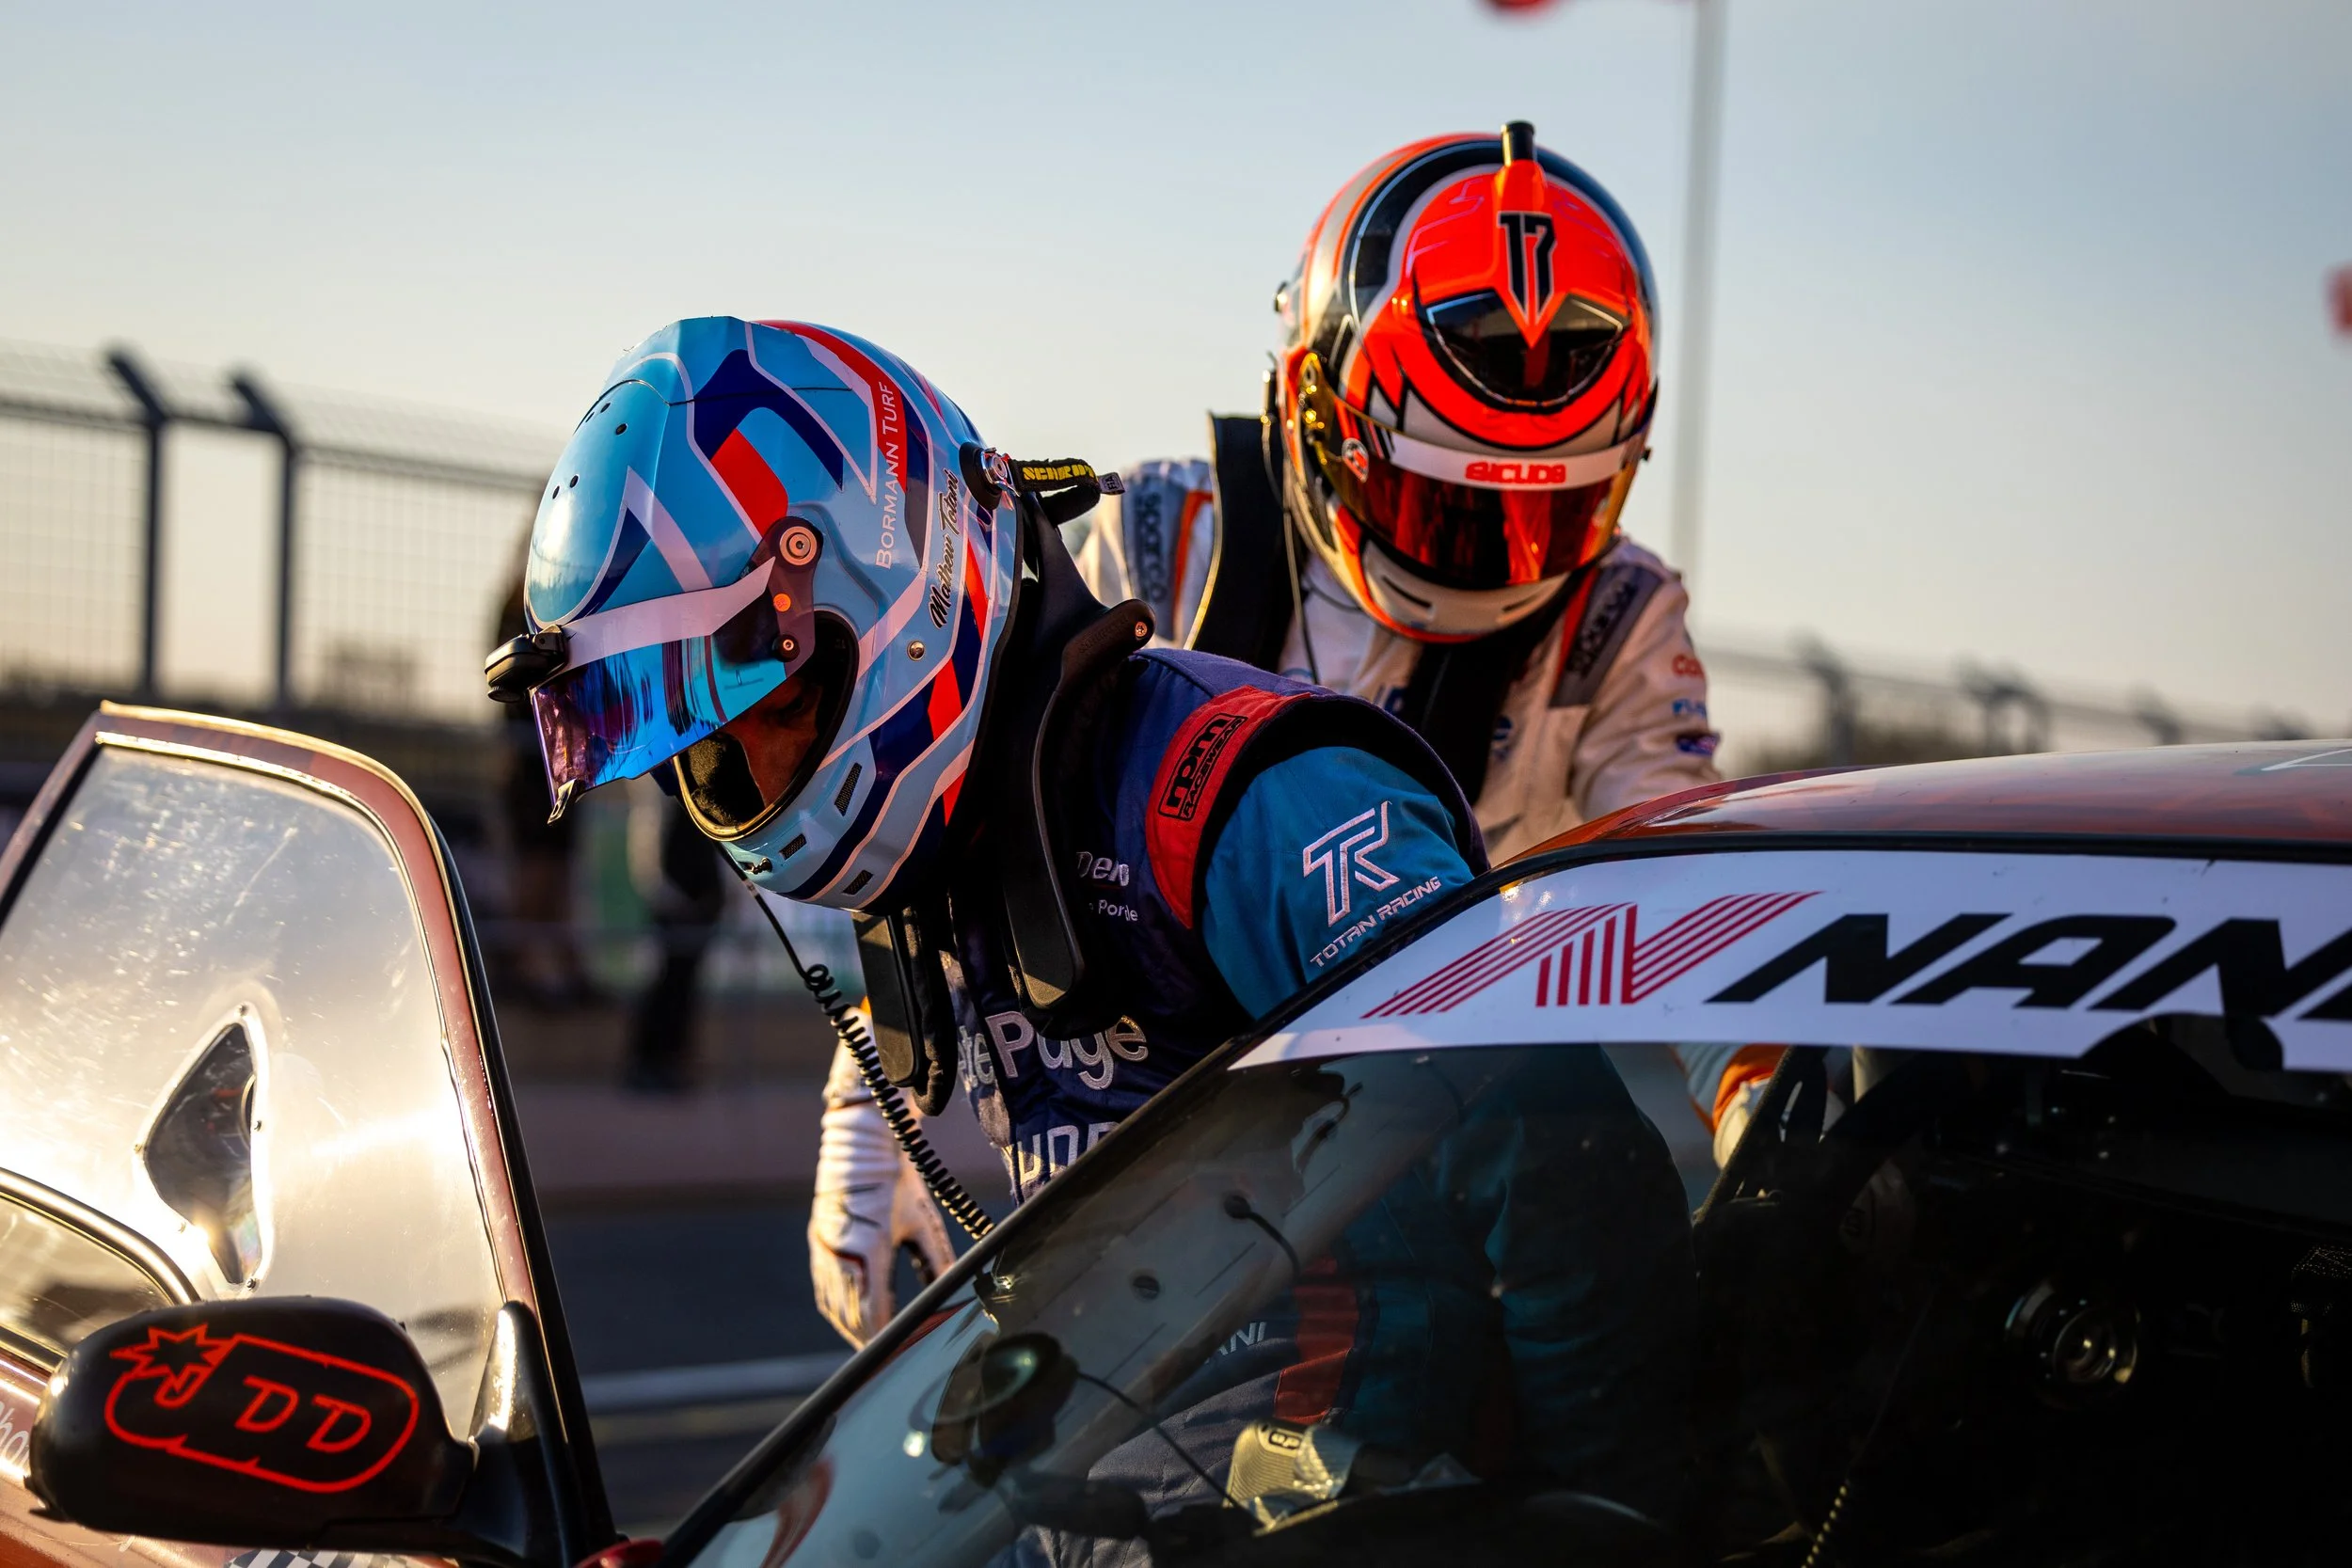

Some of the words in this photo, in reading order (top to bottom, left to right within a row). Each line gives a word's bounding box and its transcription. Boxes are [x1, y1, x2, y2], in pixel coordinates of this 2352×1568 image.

[1498, 211, 1557, 325] 17
[879, 381, 899, 436] TURF
[876, 442, 899, 569] BORMANN
[938, 468, 961, 536] Totani
[929, 533, 955, 630] Mathew
[1167, 719, 1229, 808] rpm
[1183, 717, 1243, 818] RACEWEAR
[1310, 914, 1378, 968] TOTAN
[1376, 876, 1442, 921] RACING
